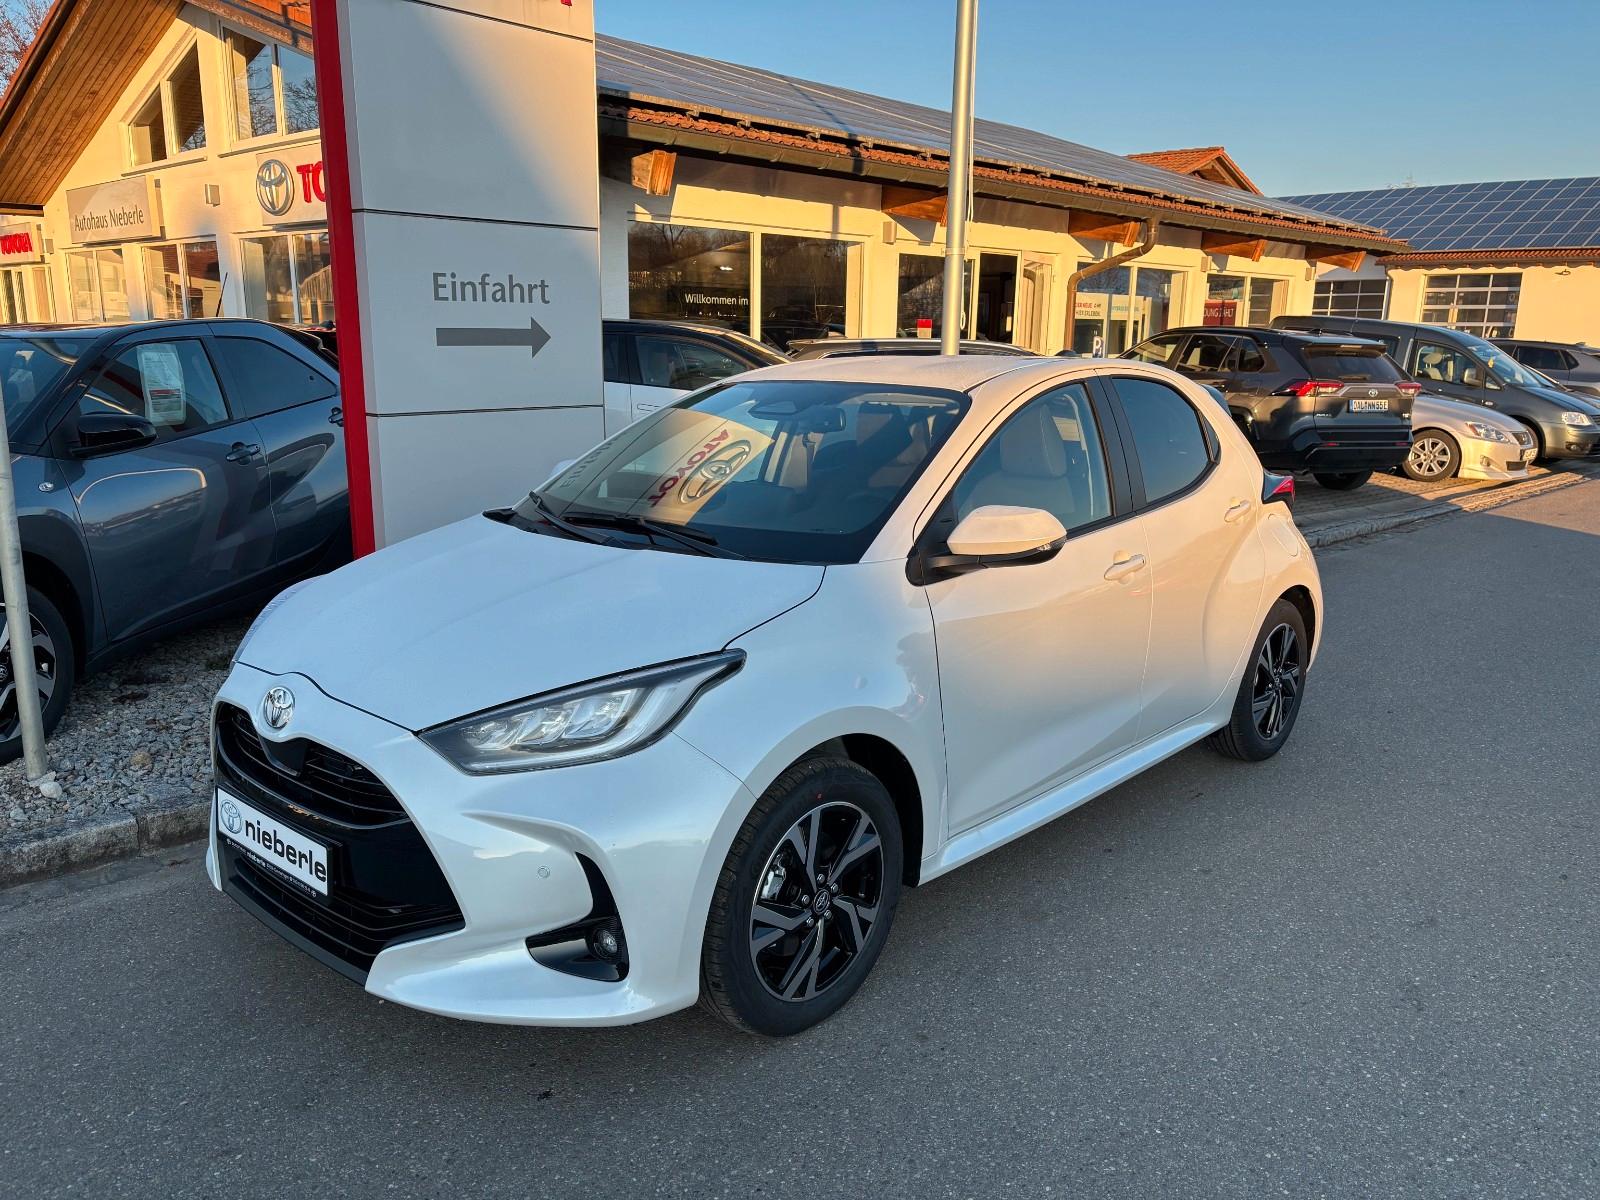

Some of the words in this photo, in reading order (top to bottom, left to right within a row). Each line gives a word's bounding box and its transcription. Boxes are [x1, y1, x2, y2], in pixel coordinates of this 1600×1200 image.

[74, 211, 109, 232] Autohaus
[109, 206, 144, 228] Nieberle
[432, 272, 550, 305] Einfahrt
[685, 293, 737, 305] Willkommen
[738, 296, 749, 306] im
[245, 820, 328, 882] nieberle
